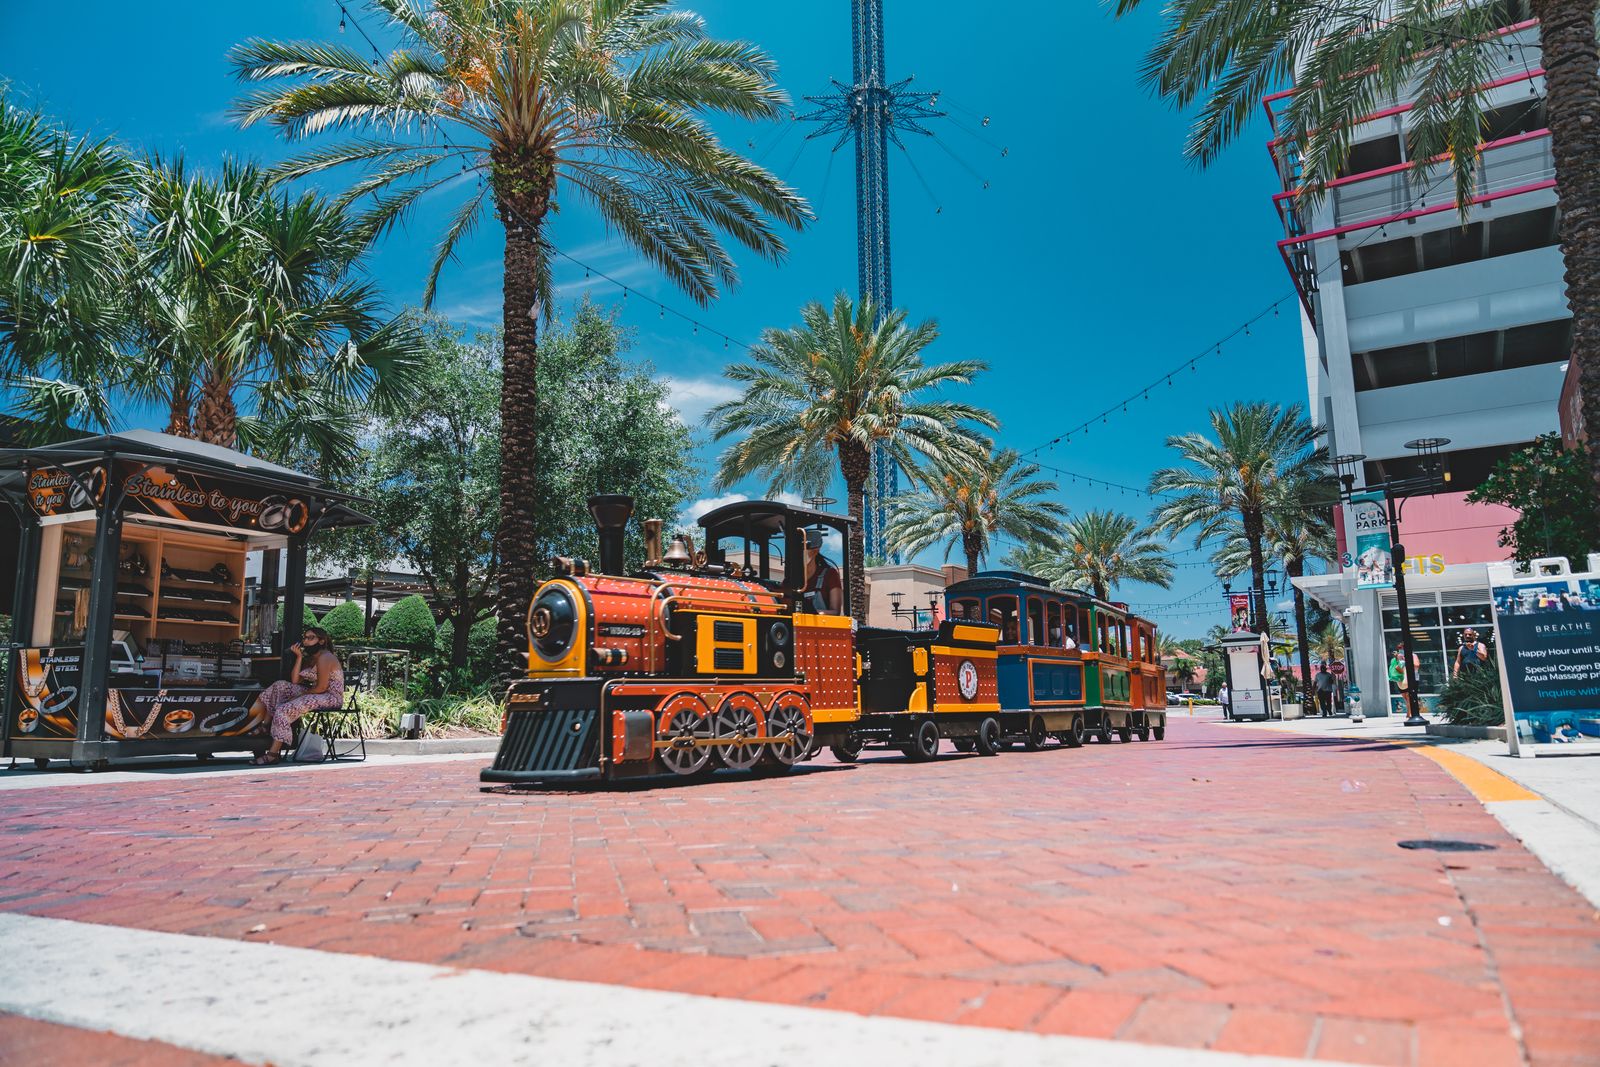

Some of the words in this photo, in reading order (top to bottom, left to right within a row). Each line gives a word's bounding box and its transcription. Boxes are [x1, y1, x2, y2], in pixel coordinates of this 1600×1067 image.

[31, 473, 70, 489] Stainless
[36, 493, 44, 506] to
[46, 494, 62, 512] you
[127, 476, 205, 505] Stainless
[210, 491, 226, 508] to
[231, 498, 260, 519] you
[1356, 518, 1386, 529] PARK
[1535, 622, 1592, 633] BREATHE
[1518, 650, 1547, 658] Happy
[1548, 648, 1570, 656] Hour
[1572, 646, 1593, 654] until
[40, 656, 80, 664] STAINLESS
[1525, 664, 1557, 674] Special
[1558, 663, 1592, 672] Oxygen
[966, 670, 972, 688] P
[1524, 674, 1548, 683] Aqua
[1549, 672, 1588, 680] Massage
[134, 695, 201, 703] STAINLESS
[203, 695, 238, 703] STEEL
[1538, 689, 1577, 699] Inquire
